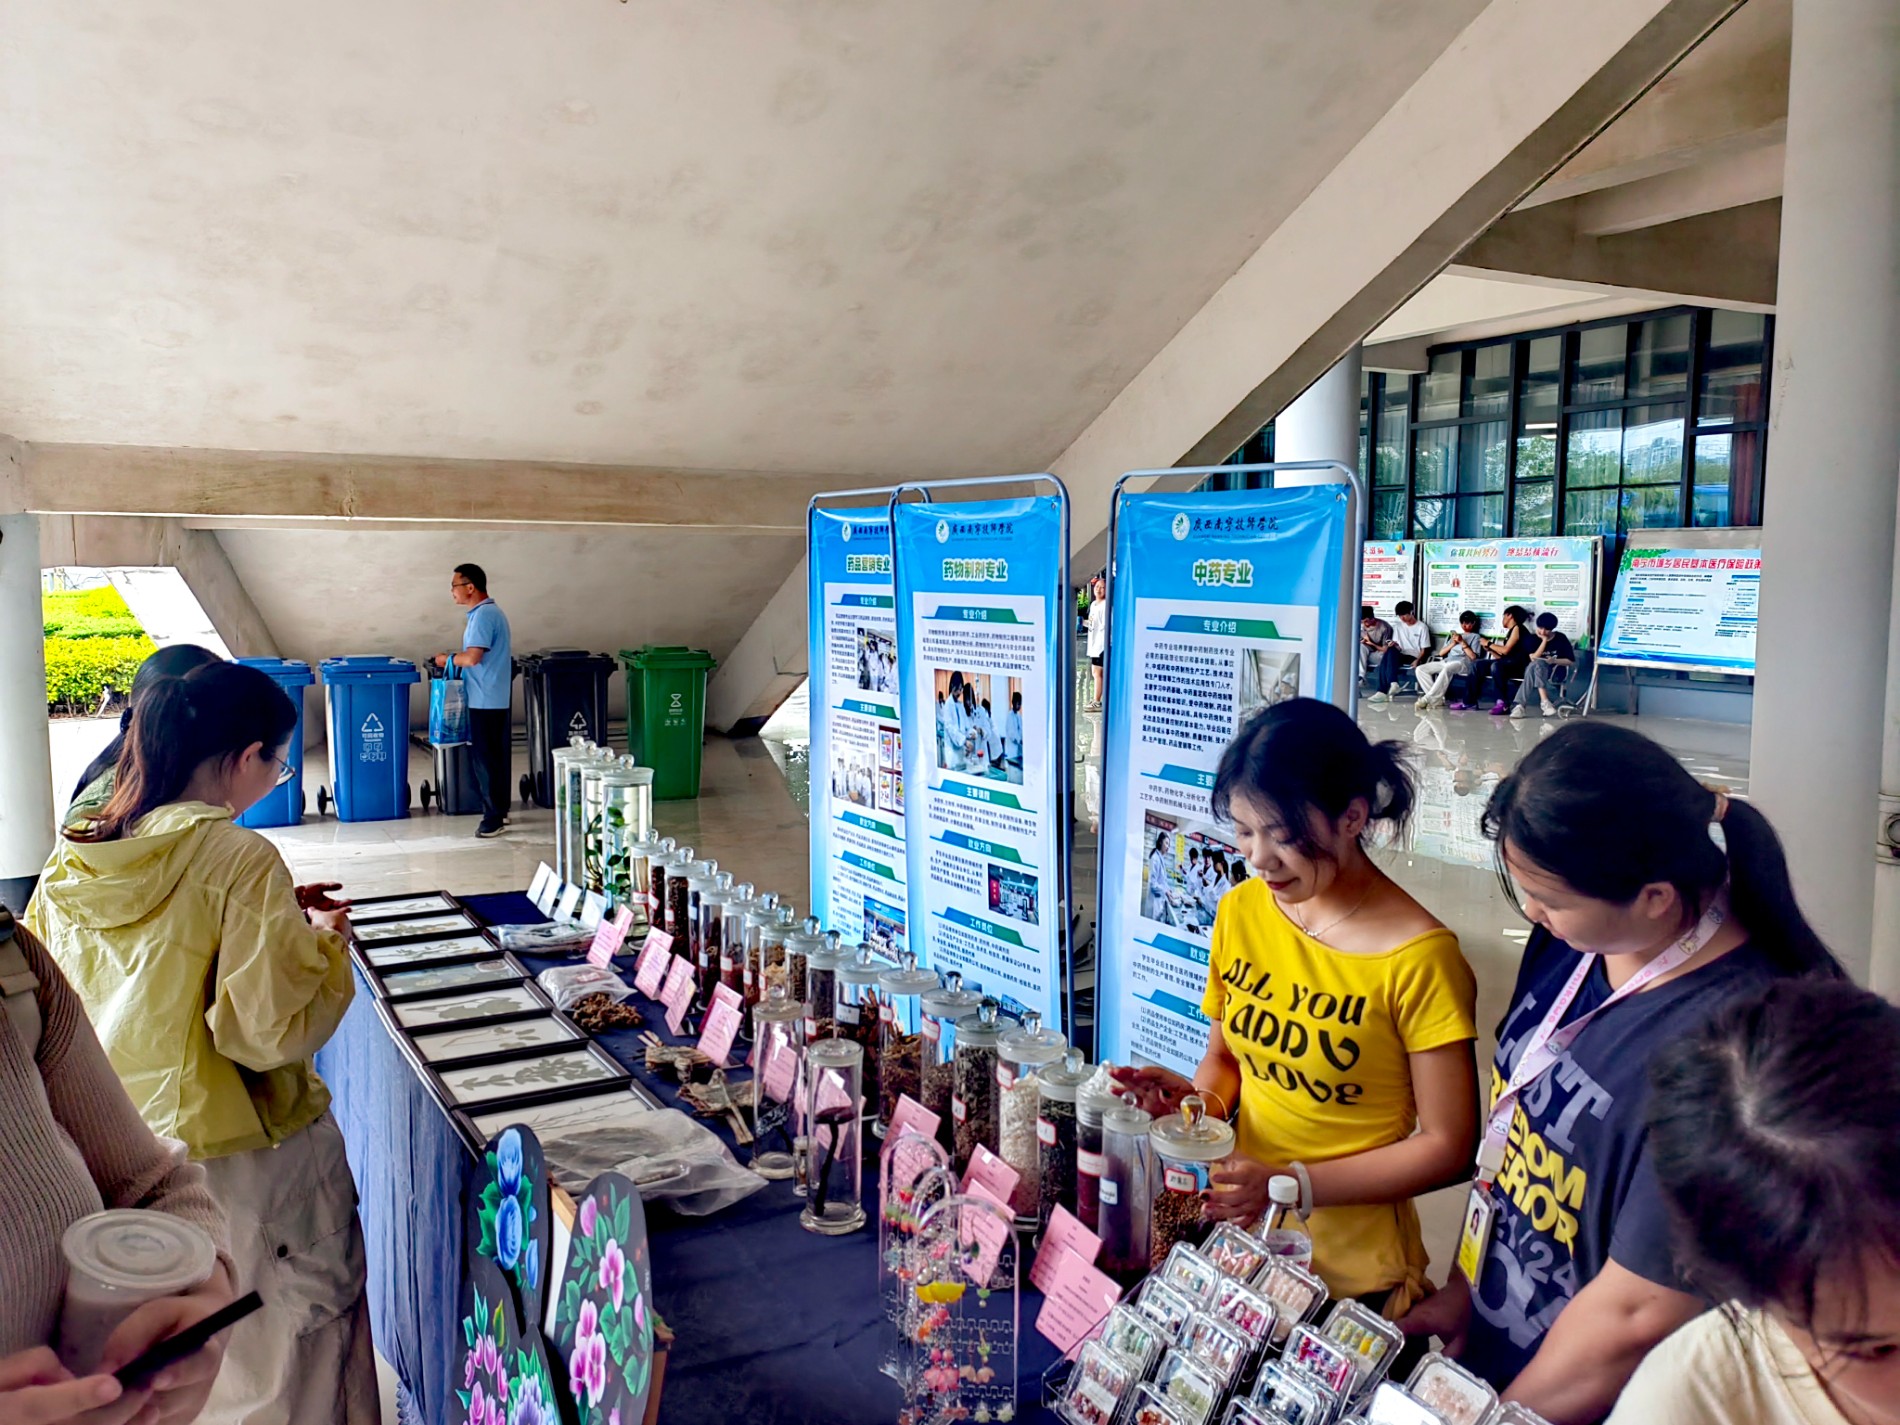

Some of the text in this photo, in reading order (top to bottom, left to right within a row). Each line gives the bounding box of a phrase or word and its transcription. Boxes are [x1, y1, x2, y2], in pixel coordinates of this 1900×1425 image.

[1450, 548, 1498, 557] 你我共同努力
[1506, 547, 1559, 557] 终结结核流行
[847, 555, 891, 573] 药品营销专业
[943, 560, 1007, 580] 药物制剂专业
[1194, 561, 1252, 585] 中药专业
[963, 609, 987, 620] 专业介绍
[1203, 620, 1236, 634] 专业介绍
[967, 838, 992, 854] 就业方向
[1222, 958, 1367, 1026] ALL YOU
[1243, 1052, 1364, 1106] LOVE
